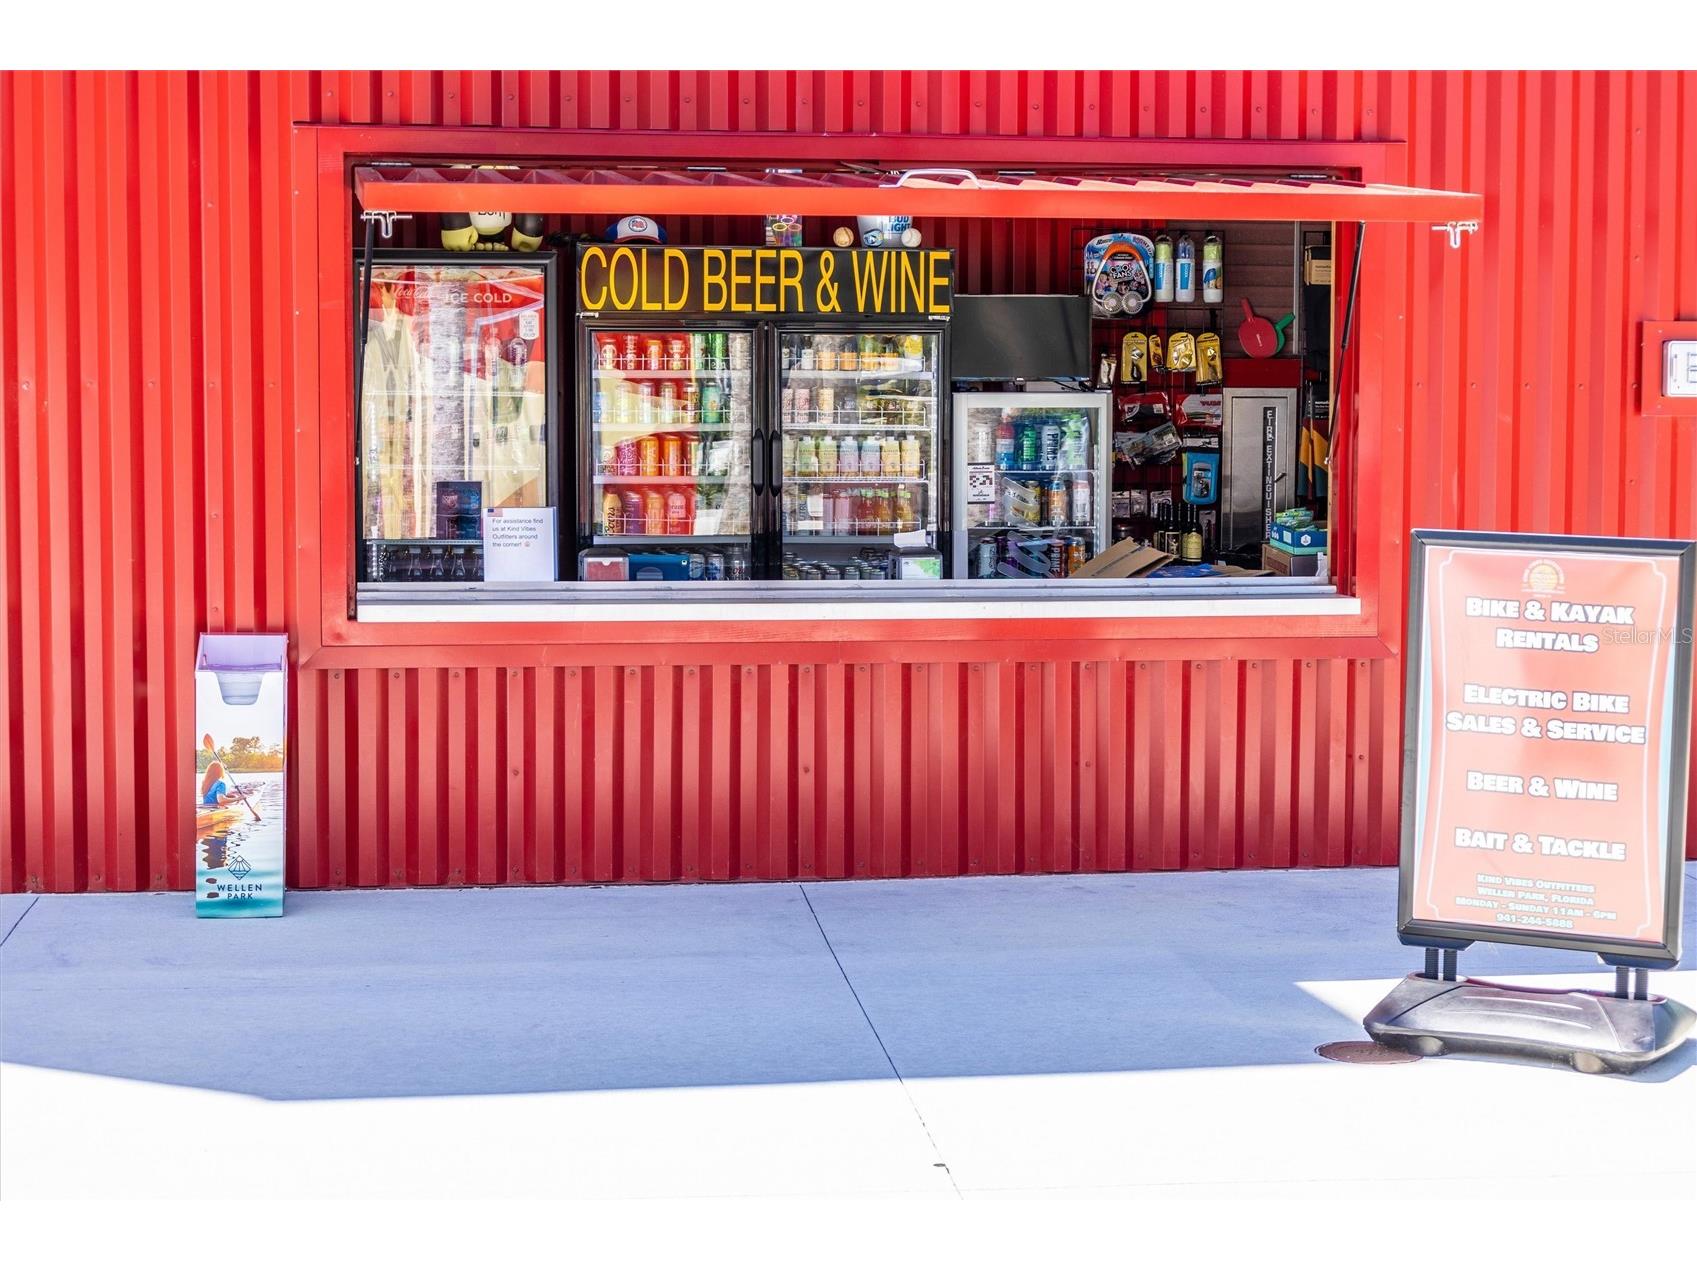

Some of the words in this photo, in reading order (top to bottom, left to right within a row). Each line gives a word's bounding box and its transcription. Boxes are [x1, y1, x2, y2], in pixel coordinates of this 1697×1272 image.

[581, 247, 690, 310] COLD
[703, 249, 804, 312] BEER
[816, 250, 841, 313] &
[852, 250, 950, 314] WINE
[474, 292, 512, 303] COLD
[1266, 410, 1274, 442] FIRE
[1265, 445, 1273, 540] EXTINGUISHER
[1465, 596, 1520, 619] BIKE
[1524, 599, 1547, 622] &
[1550, 601, 1635, 625] KAYAK
[1496, 627, 1600, 654] RENTALS
[1463, 683, 1568, 710] ELECTRIC
[1571, 690, 1630, 714] BIKE
[1446, 711, 1516, 735] SALES
[1519, 716, 1544, 739] &
[1546, 718, 1646, 745] SERVICE
[1466, 769, 1525, 795] BEER
[1527, 775, 1550, 798] &
[1553, 776, 1619, 802] WINE
[1454, 827, 1508, 851] BAIT
[1511, 832, 1534, 855] &
[1538, 834, 1627, 862] TACKLE
